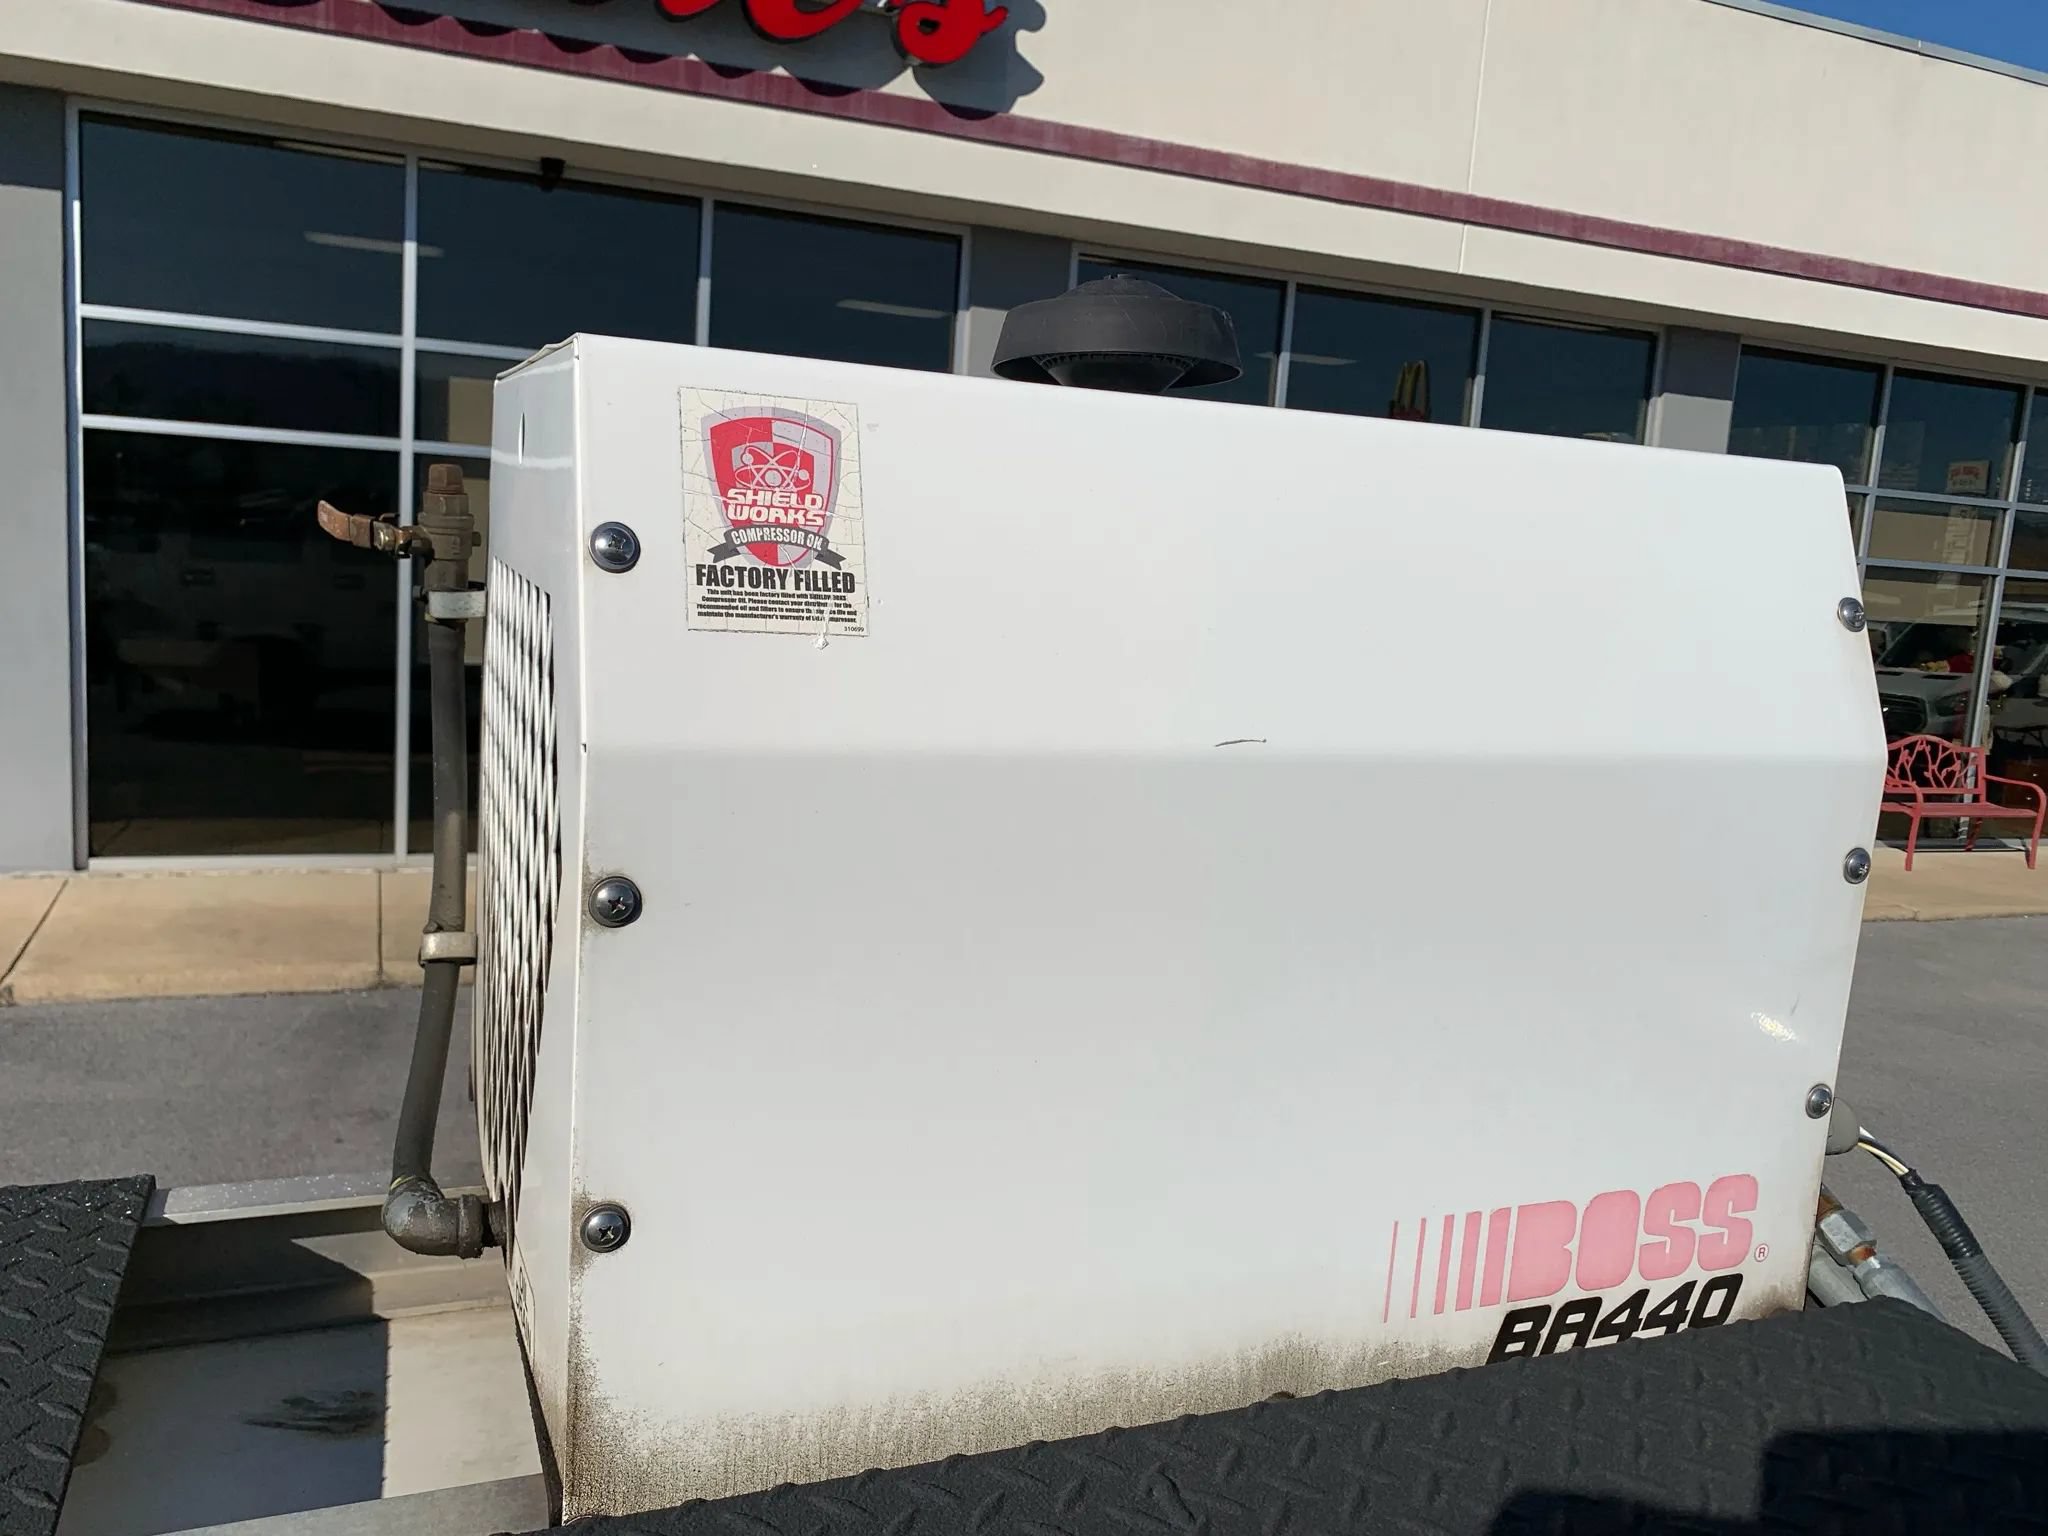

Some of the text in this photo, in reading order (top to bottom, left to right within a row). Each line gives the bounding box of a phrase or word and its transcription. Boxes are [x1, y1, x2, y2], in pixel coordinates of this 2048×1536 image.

[727, 488, 824, 509] SHIELD
[727, 504, 825, 526] WORKS
[731, 527, 805, 545] COMPRESSOR
[695, 564, 856, 594] FACTORY FILLED
[697, 603, 739, 611] recommended
[1507, 1174, 1759, 1302] BOSS
[1484, 1273, 1744, 1365] BA440
